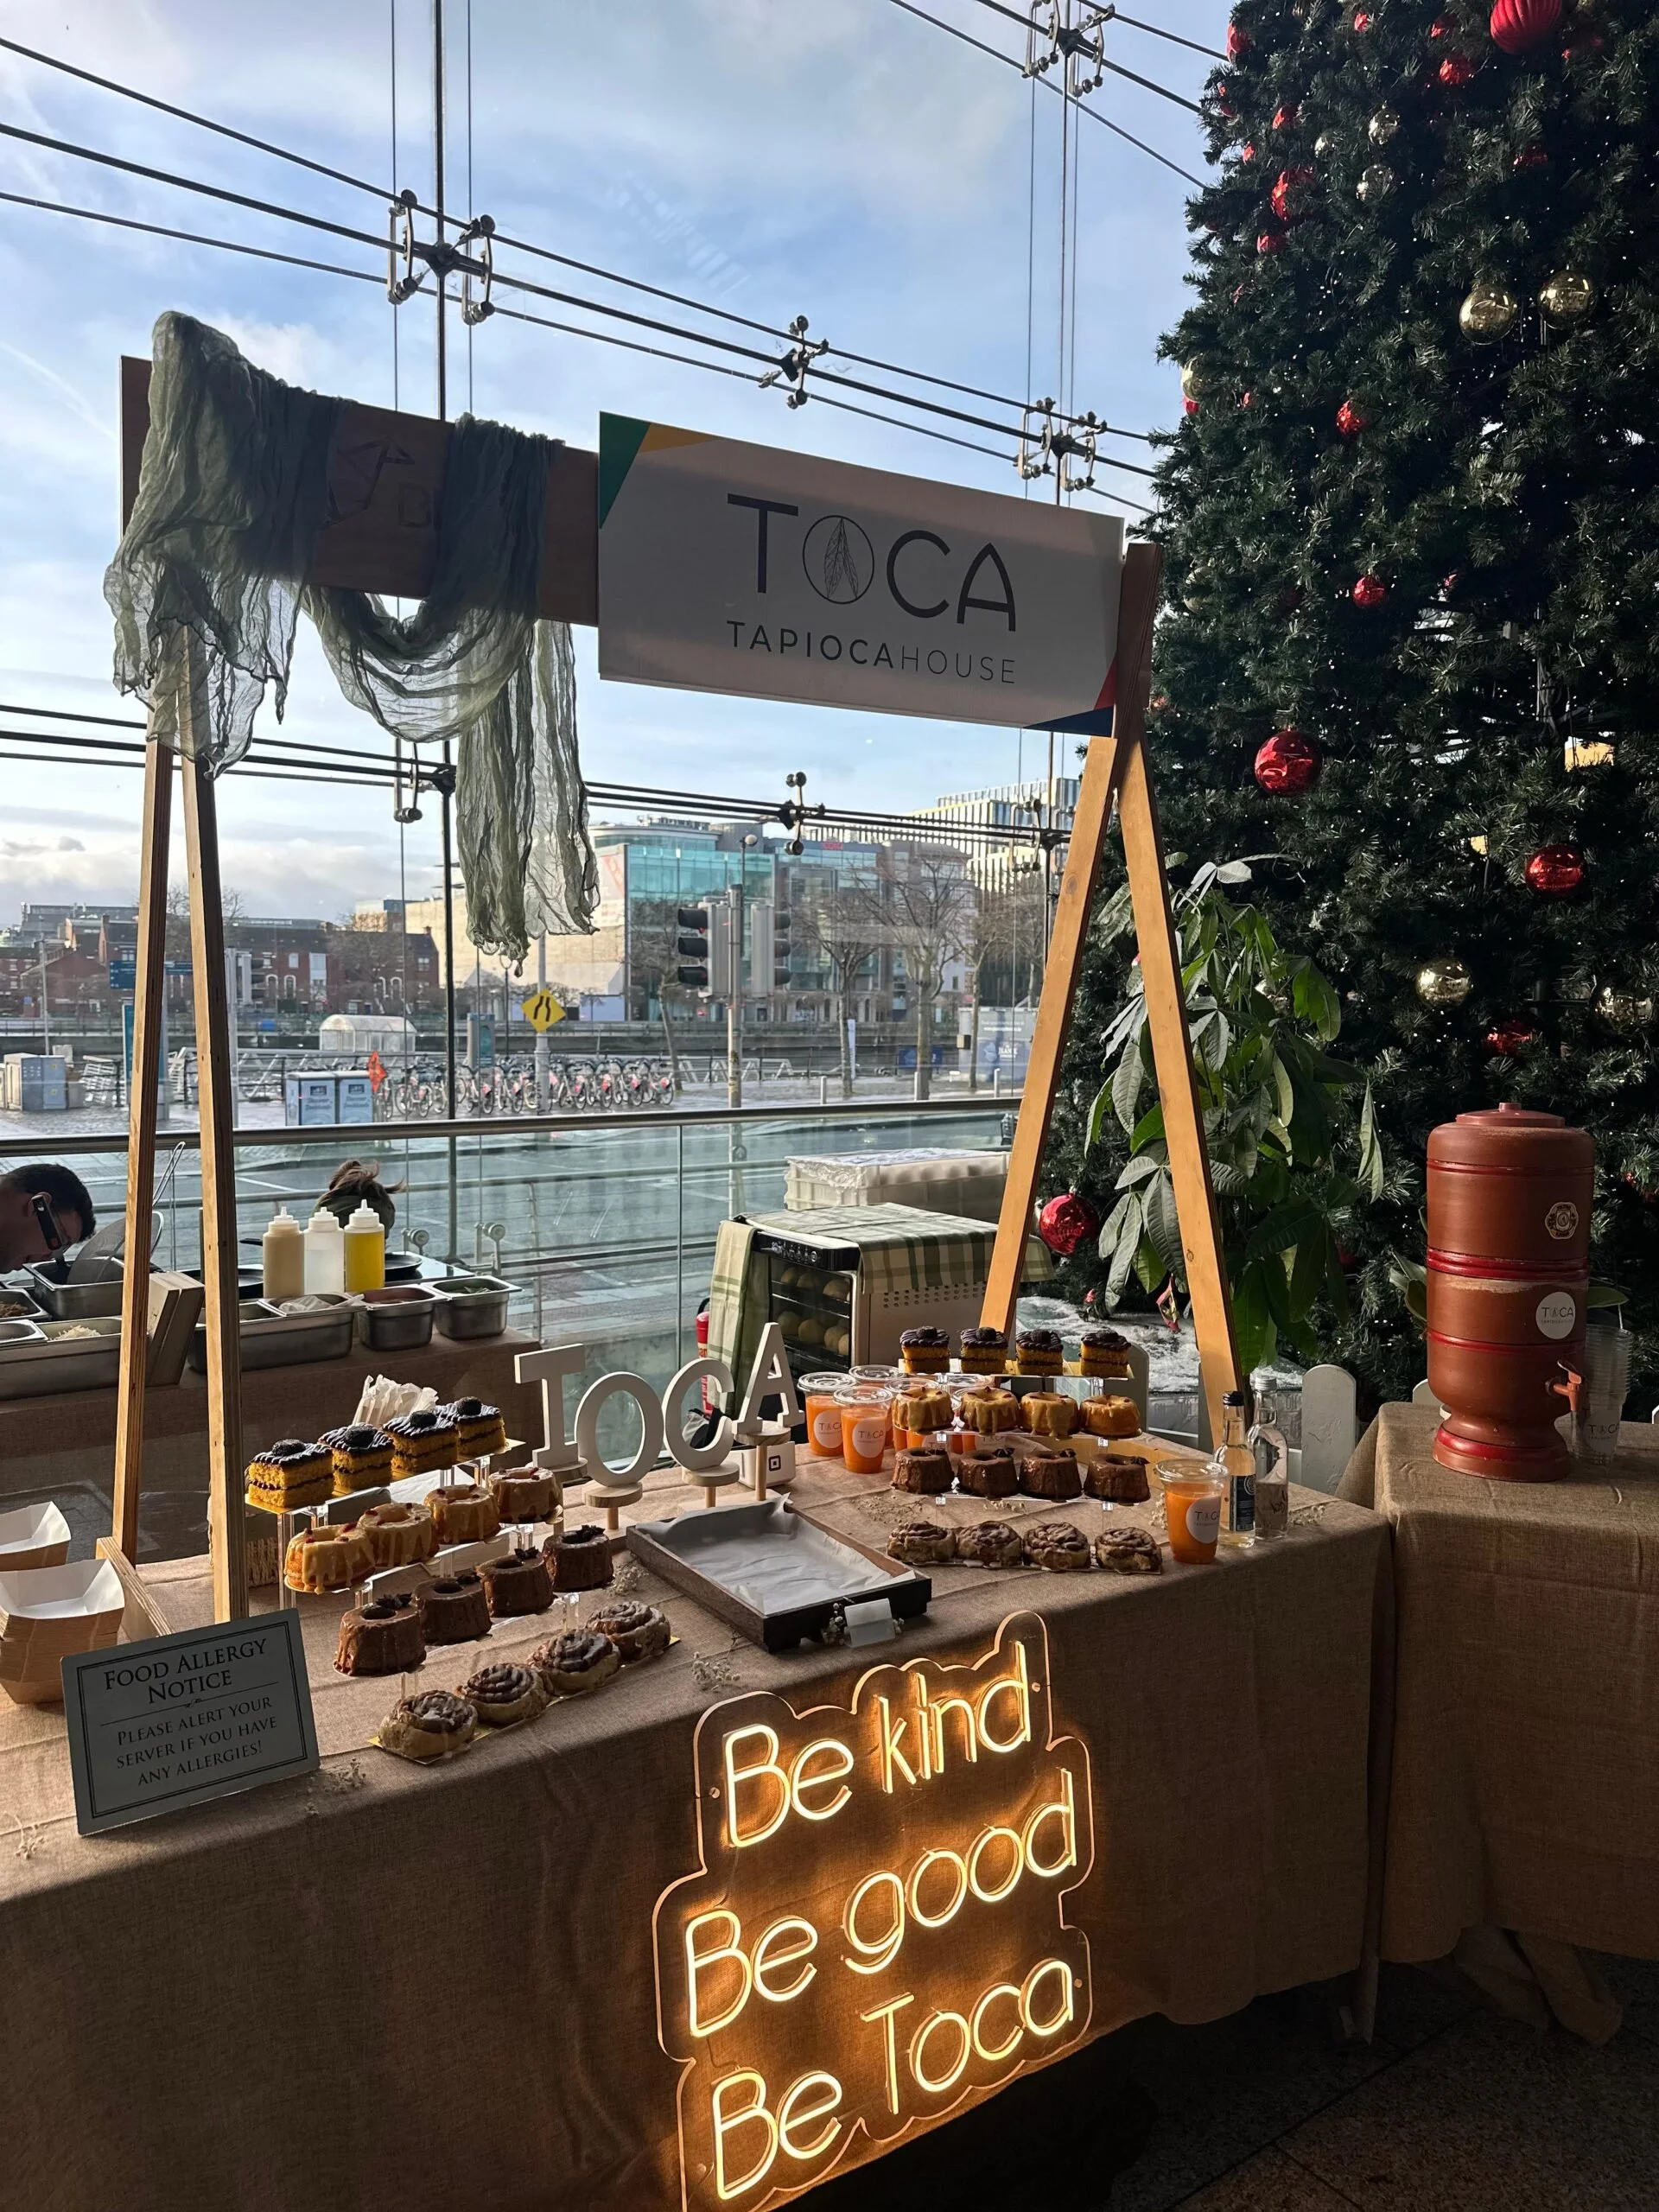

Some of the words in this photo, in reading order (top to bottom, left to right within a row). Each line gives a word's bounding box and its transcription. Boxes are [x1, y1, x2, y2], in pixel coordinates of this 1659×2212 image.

[728, 493, 1016, 632] TOCA
[514, 1322, 805, 1487] TOCA
[103, 1662, 169, 1690] FOOD
[177, 1638, 267, 1674] ALLERGY
[148, 1670, 232, 1704] NOTICE
[117, 1723, 173, 1746] PLEASE
[178, 1708, 225, 1732] ALERT
[228, 1696, 273, 1718] YOUR
[117, 1744, 175, 1770] SERVER
[181, 1738, 194, 1753] IF
[199, 1727, 232, 1748] YOU
[238, 1716, 277, 1737] HAVE
[138, 1766, 171, 1787] ANY
[176, 1739, 264, 1776] ALLERGIES!
[723, 1722, 855, 1848] Be
[877, 1640, 1033, 1794] kind
[685, 1909, 818, 2039] Be
[842, 1767, 1077, 1975] good
[713, 2066, 842, 2201] Be
[860, 1957, 1075, 2115] Toca
